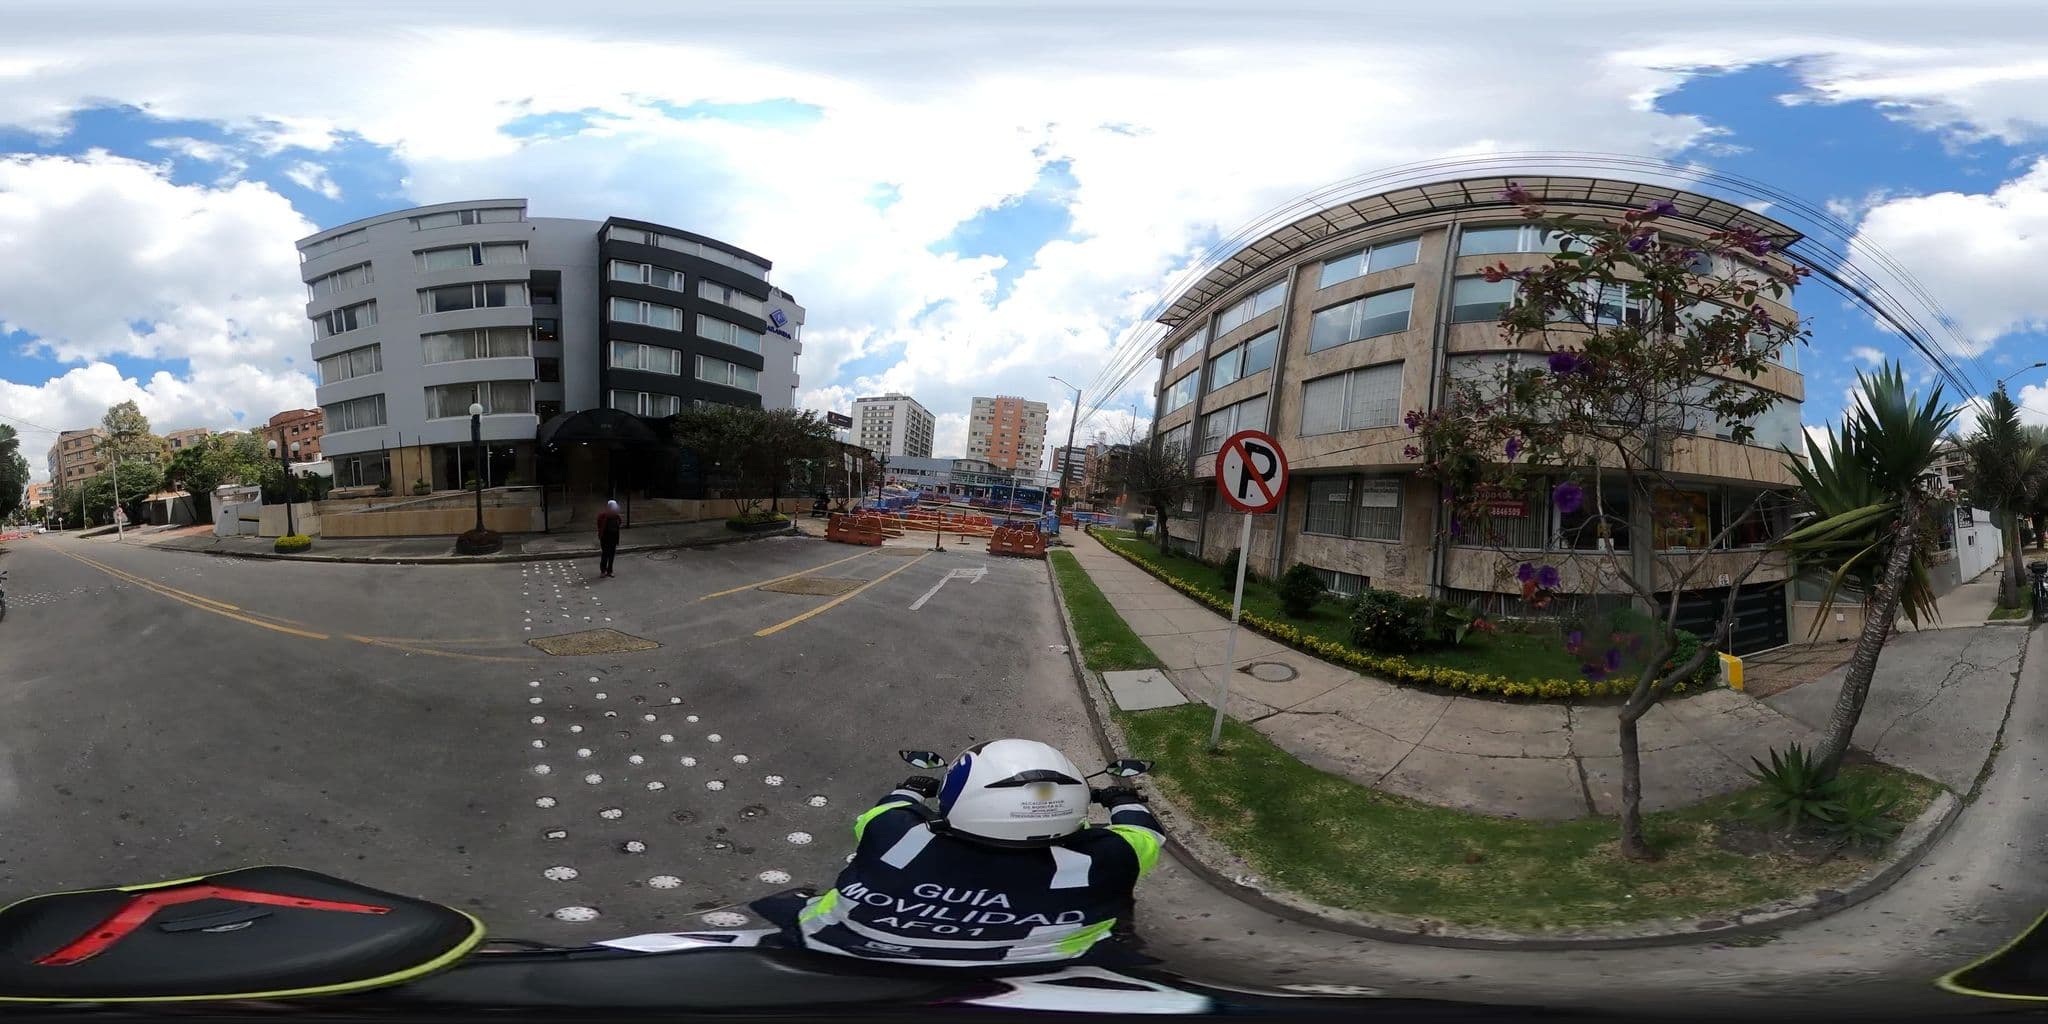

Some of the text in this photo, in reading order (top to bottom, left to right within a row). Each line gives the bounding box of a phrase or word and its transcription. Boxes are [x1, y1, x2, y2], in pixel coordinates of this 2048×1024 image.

[1238, 441, 1277, 499] P
[841, 882, 1084, 925] MOVILIDAD
[913, 882, 1012, 909] GUÍA
